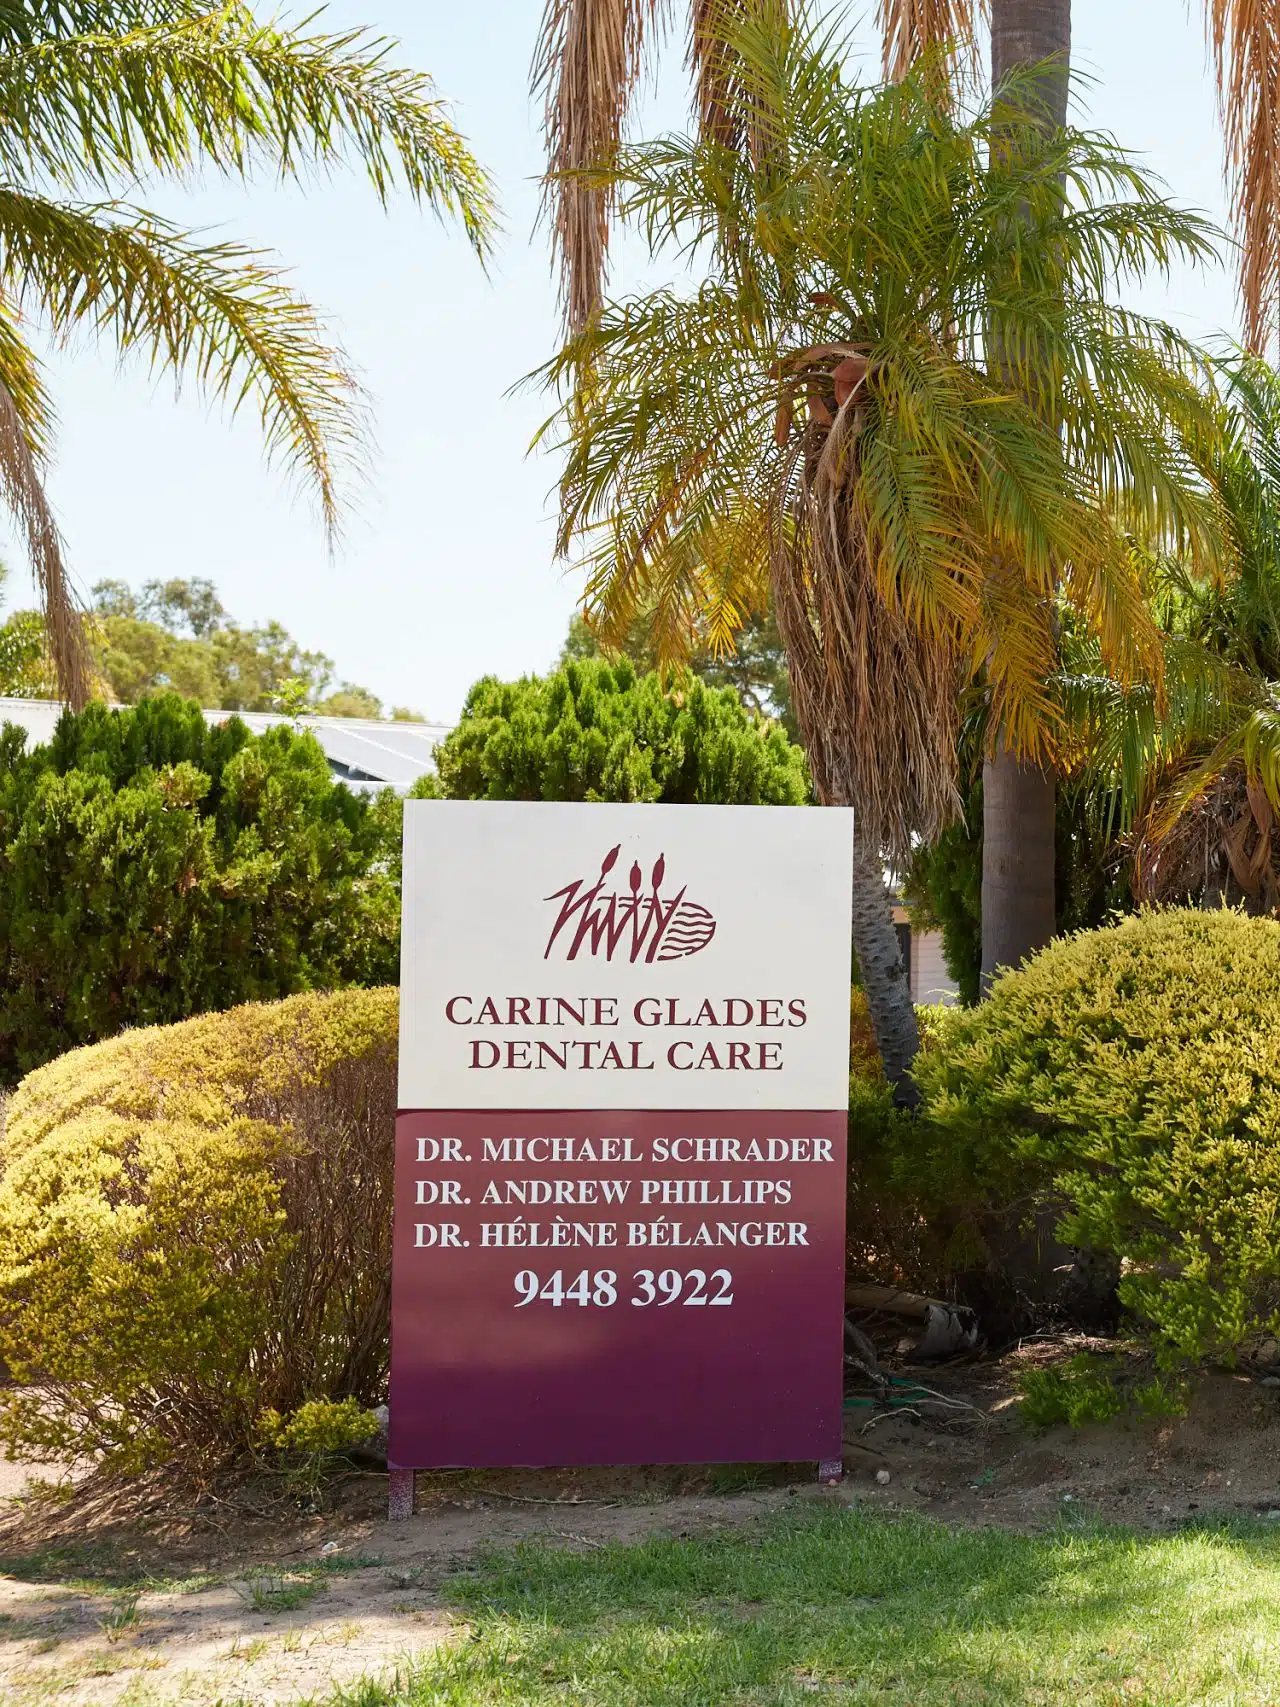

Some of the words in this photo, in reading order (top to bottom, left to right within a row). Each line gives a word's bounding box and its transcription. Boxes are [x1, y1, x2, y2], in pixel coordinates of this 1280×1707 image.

[445, 996, 620, 1026] CARINE
[633, 997, 807, 1028] GLADES
[467, 1040, 655, 1070] DENTAL
[666, 1041, 784, 1071] CARE
[415, 1137, 472, 1162] DR.
[481, 1137, 644, 1162] MICHAEL
[651, 1137, 835, 1163] SCHRADER
[414, 1180, 471, 1205] DR.
[479, 1180, 632, 1205] ANDREW
[639, 1179, 792, 1205] PHILLIPS
[413, 1223, 470, 1248] DR.
[479, 1215, 618, 1247] HÉLÈNE
[626, 1215, 810, 1247] BÉLANGER
[513, 1269, 618, 1308] 9448
[631, 1268, 734, 1307] 3922
